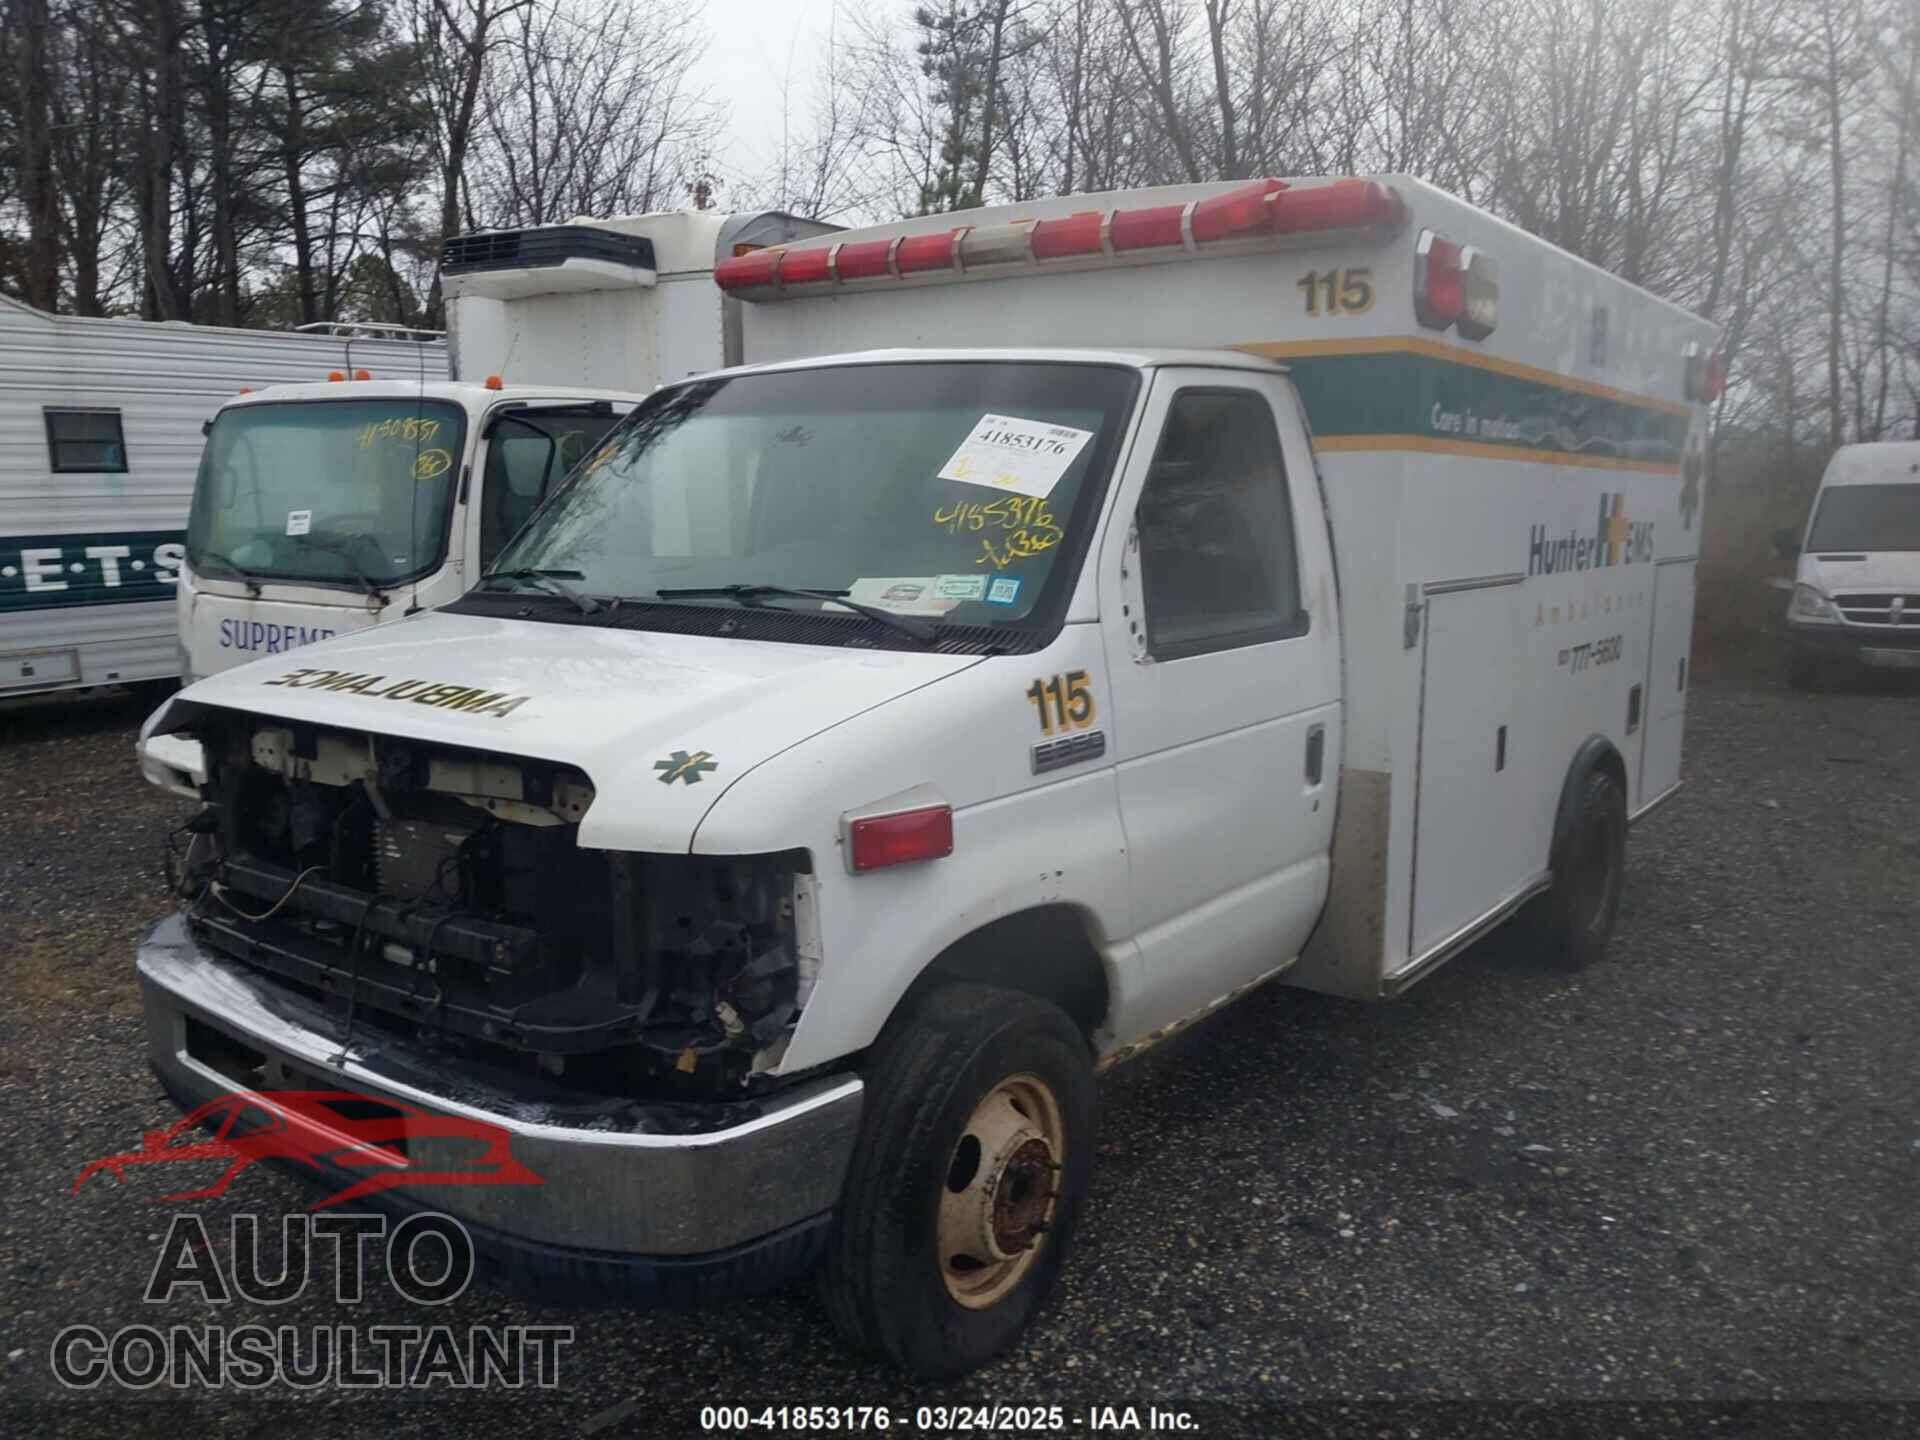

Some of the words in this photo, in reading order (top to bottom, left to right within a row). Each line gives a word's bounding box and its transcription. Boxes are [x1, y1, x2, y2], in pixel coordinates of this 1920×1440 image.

[1297, 268, 1376, 317] 115
[979, 429, 1067, 456] 41853176
[1431, 402, 1461, 433] Care
[1465, 409, 1478, 435] in
[1529, 524, 1595, 577] Hunter
[1624, 521, 1655, 565] EMS
[1026, 669, 1096, 736] 115
